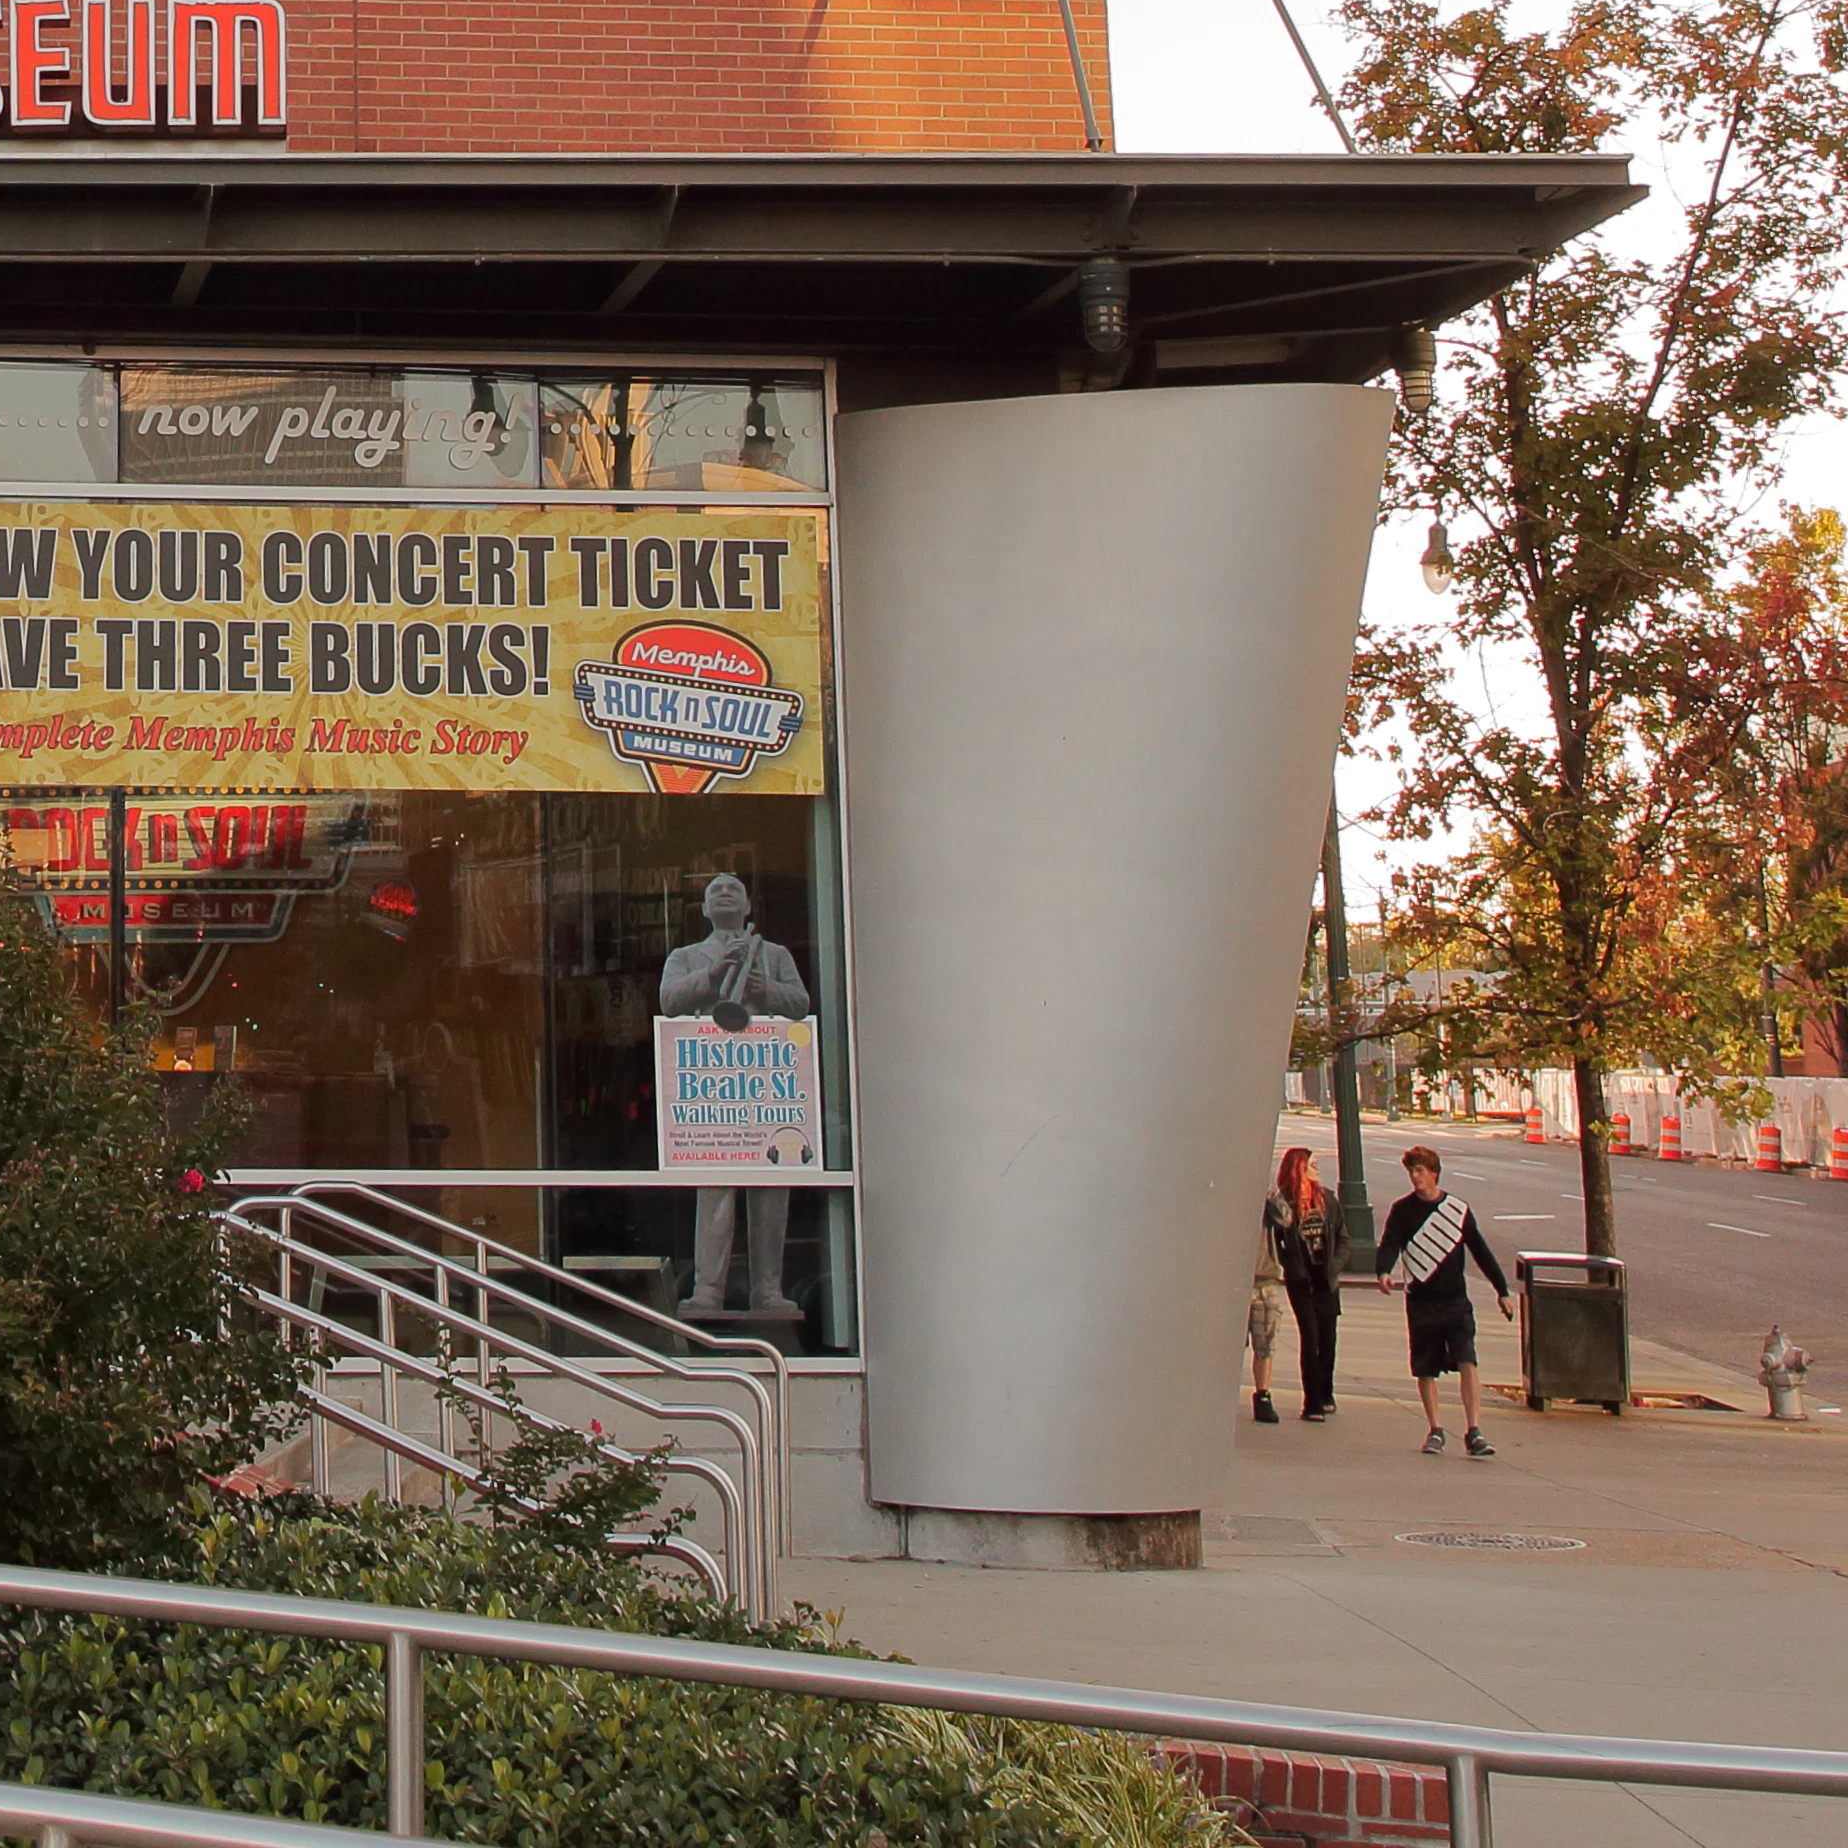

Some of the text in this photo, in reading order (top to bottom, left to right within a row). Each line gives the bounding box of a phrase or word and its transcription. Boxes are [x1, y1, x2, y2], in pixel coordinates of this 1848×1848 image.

[138, 385, 522, 471] now playing!
[71, 528, 243, 604] YOUR
[261, 530, 555, 609] CONCERT
[556, 535, 789, 612] TICKET
[95, 619, 296, 693] THREE
[309, 621, 551, 696] BUCKS!
[630, 642, 756, 678] Memphis
[603, 679, 772, 739] ROCK n SOUL
[122, 715, 296, 761] Memphis
[305, 718, 421, 754] Music
[429, 718, 530, 764] Story
[633, 735, 733, 762] MUSEUM
[183, 805, 313, 871] SOUL
[697, 1026, 719, 1035] ASK
[741, 1026, 777, 1035] ABOUT
[675, 1038, 798, 1069] Historic
[676, 1071, 807, 1101] Beale St.
[671, 1105, 805, 1125] Walking Tours
[672, 1152, 760, 1161] AVAILABLE HERE!
